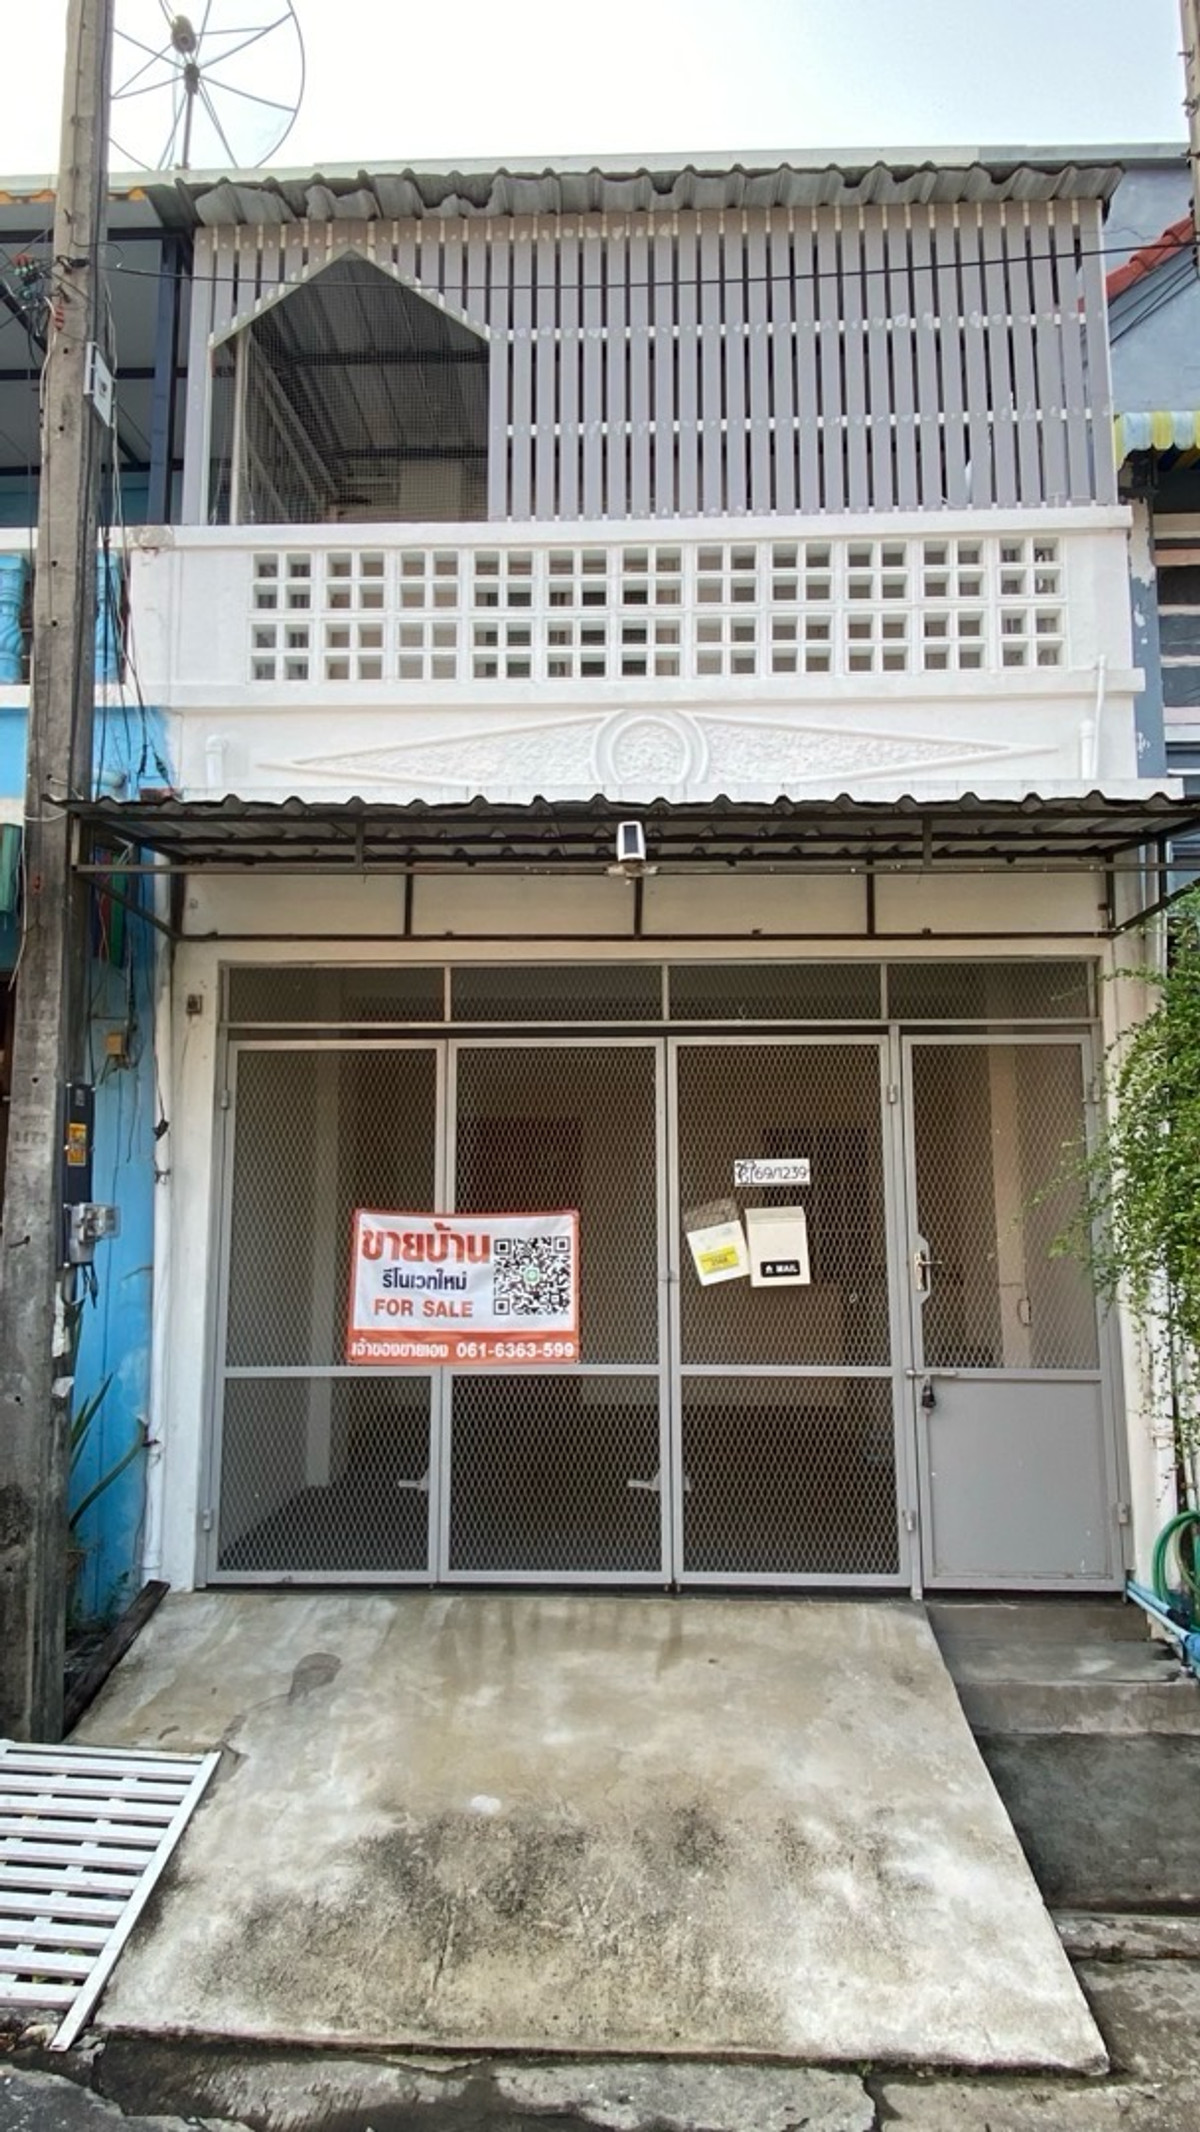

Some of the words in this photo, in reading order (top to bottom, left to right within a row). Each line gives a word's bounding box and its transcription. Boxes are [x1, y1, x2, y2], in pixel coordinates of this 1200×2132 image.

[362, 1222, 491, 1264] ขายบ้าน
[382, 1267, 467, 1290] รีโนเวทใหม่
[373, 1299, 413, 1317] FOR
[423, 1300, 473, 1318] SALE
[351, 1338, 449, 1358] เจ้าของขายเอง
[456, 1341, 574, 1358] 061-6363-599
